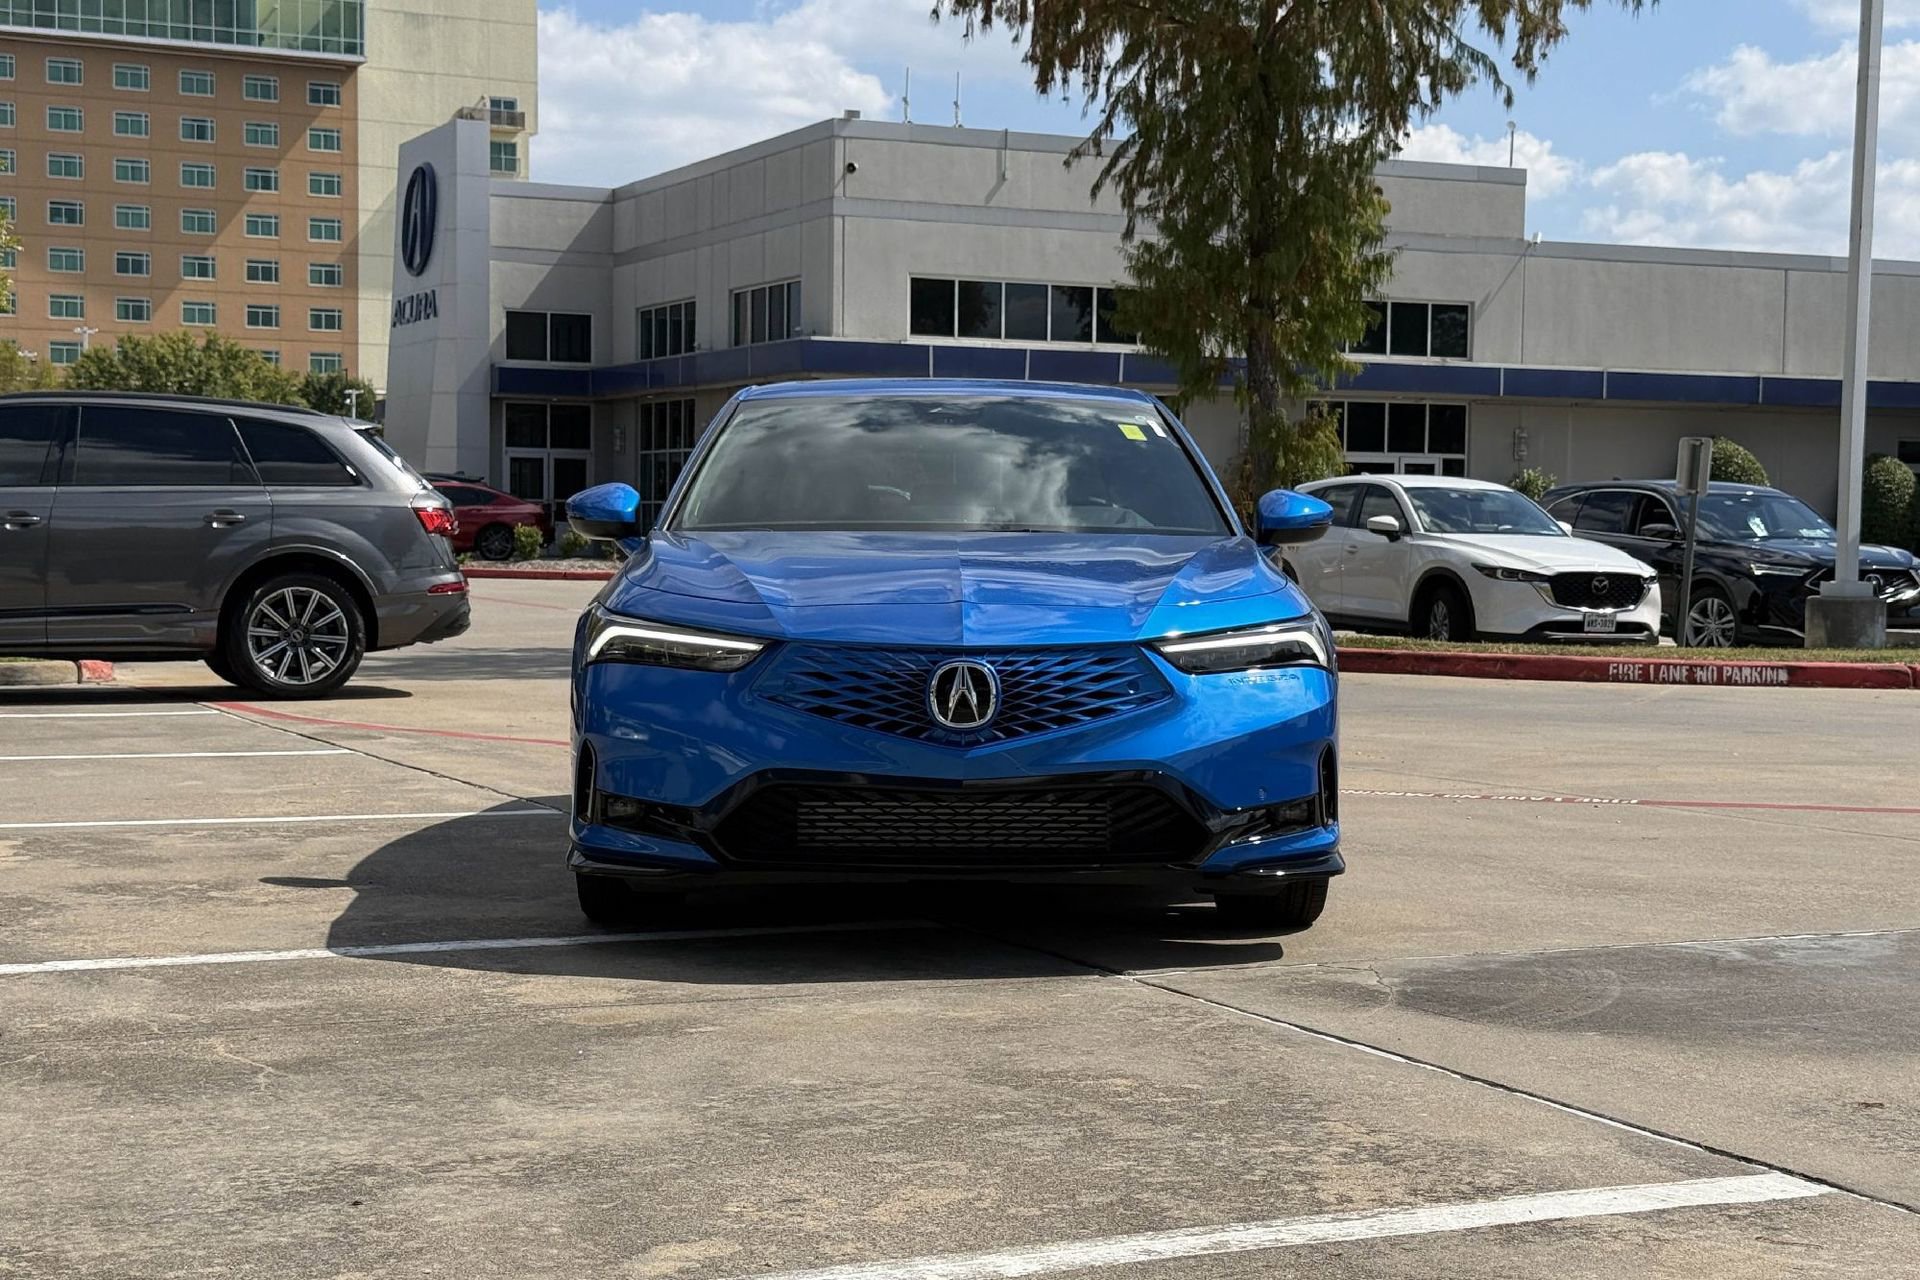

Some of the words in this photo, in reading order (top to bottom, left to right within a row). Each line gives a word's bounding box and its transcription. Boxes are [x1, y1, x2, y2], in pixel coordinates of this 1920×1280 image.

[393, 289, 438, 328] ACURA
[1609, 663, 1643, 681] FIRE
[1650, 664, 1689, 683] LANE
[1694, 666, 1717, 684] NO
